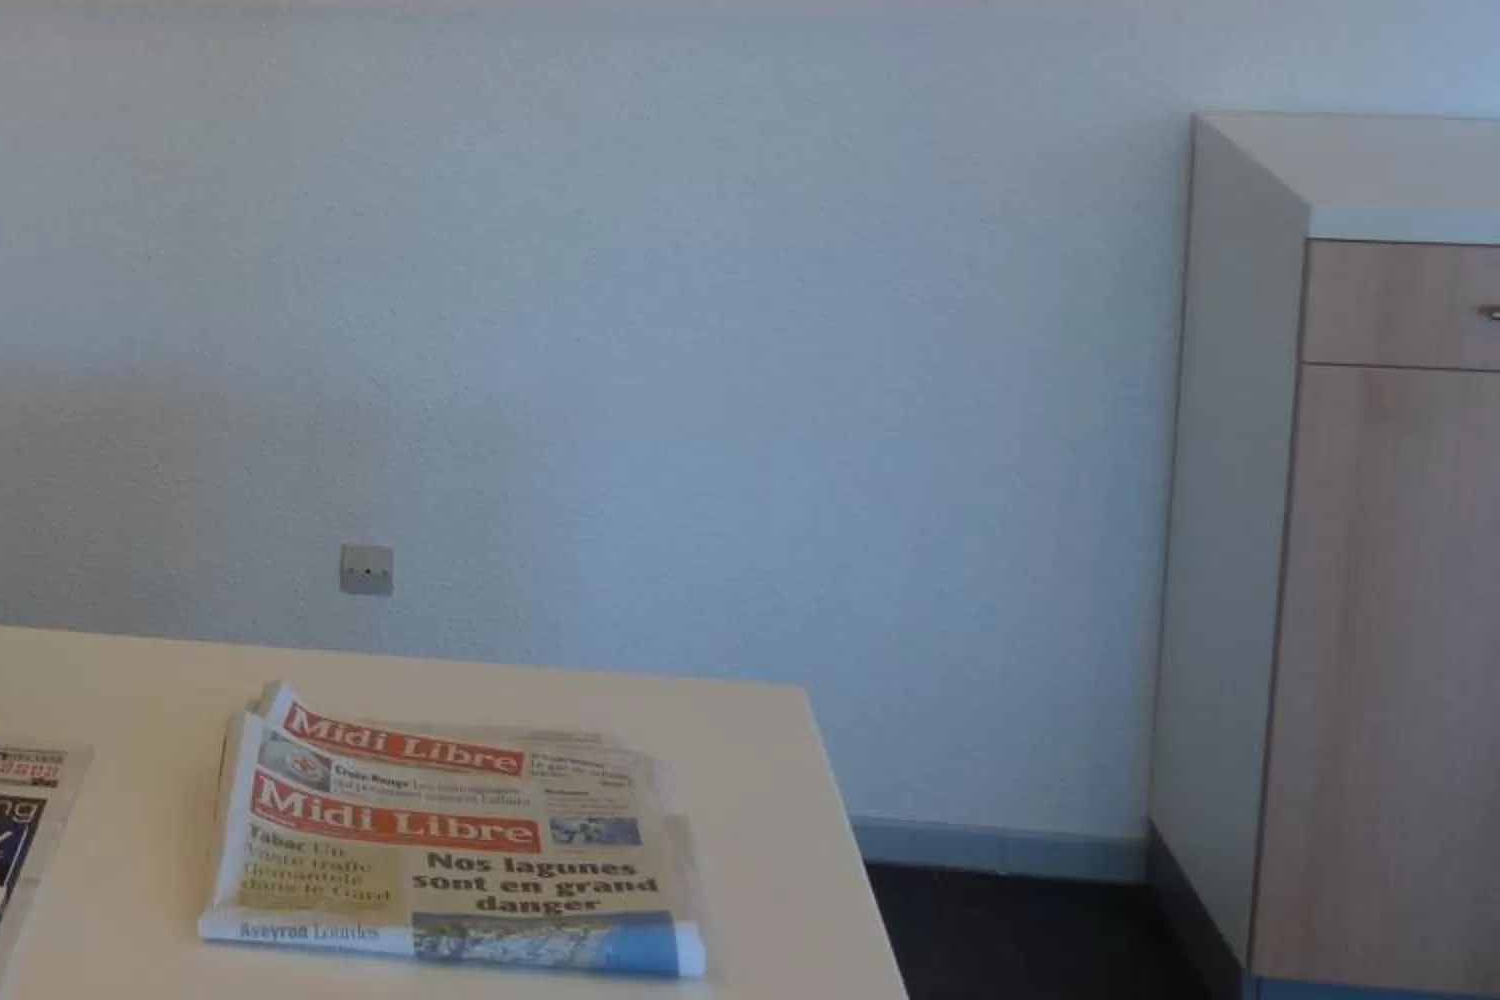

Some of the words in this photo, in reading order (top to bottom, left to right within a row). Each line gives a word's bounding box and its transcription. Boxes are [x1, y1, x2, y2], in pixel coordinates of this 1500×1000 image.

[290, 706, 386, 751] Midi
[403, 734, 519, 773] Libre
[259, 776, 374, 830] Midi
[393, 811, 534, 844] Libre
[426, 851, 493, 873] Nos
[503, 855, 639, 880] lagunes
[411, 873, 489, 893] sont
[498, 878, 542, 894] en
[554, 876, 660, 898] grand
[474, 895, 602, 916] danger
